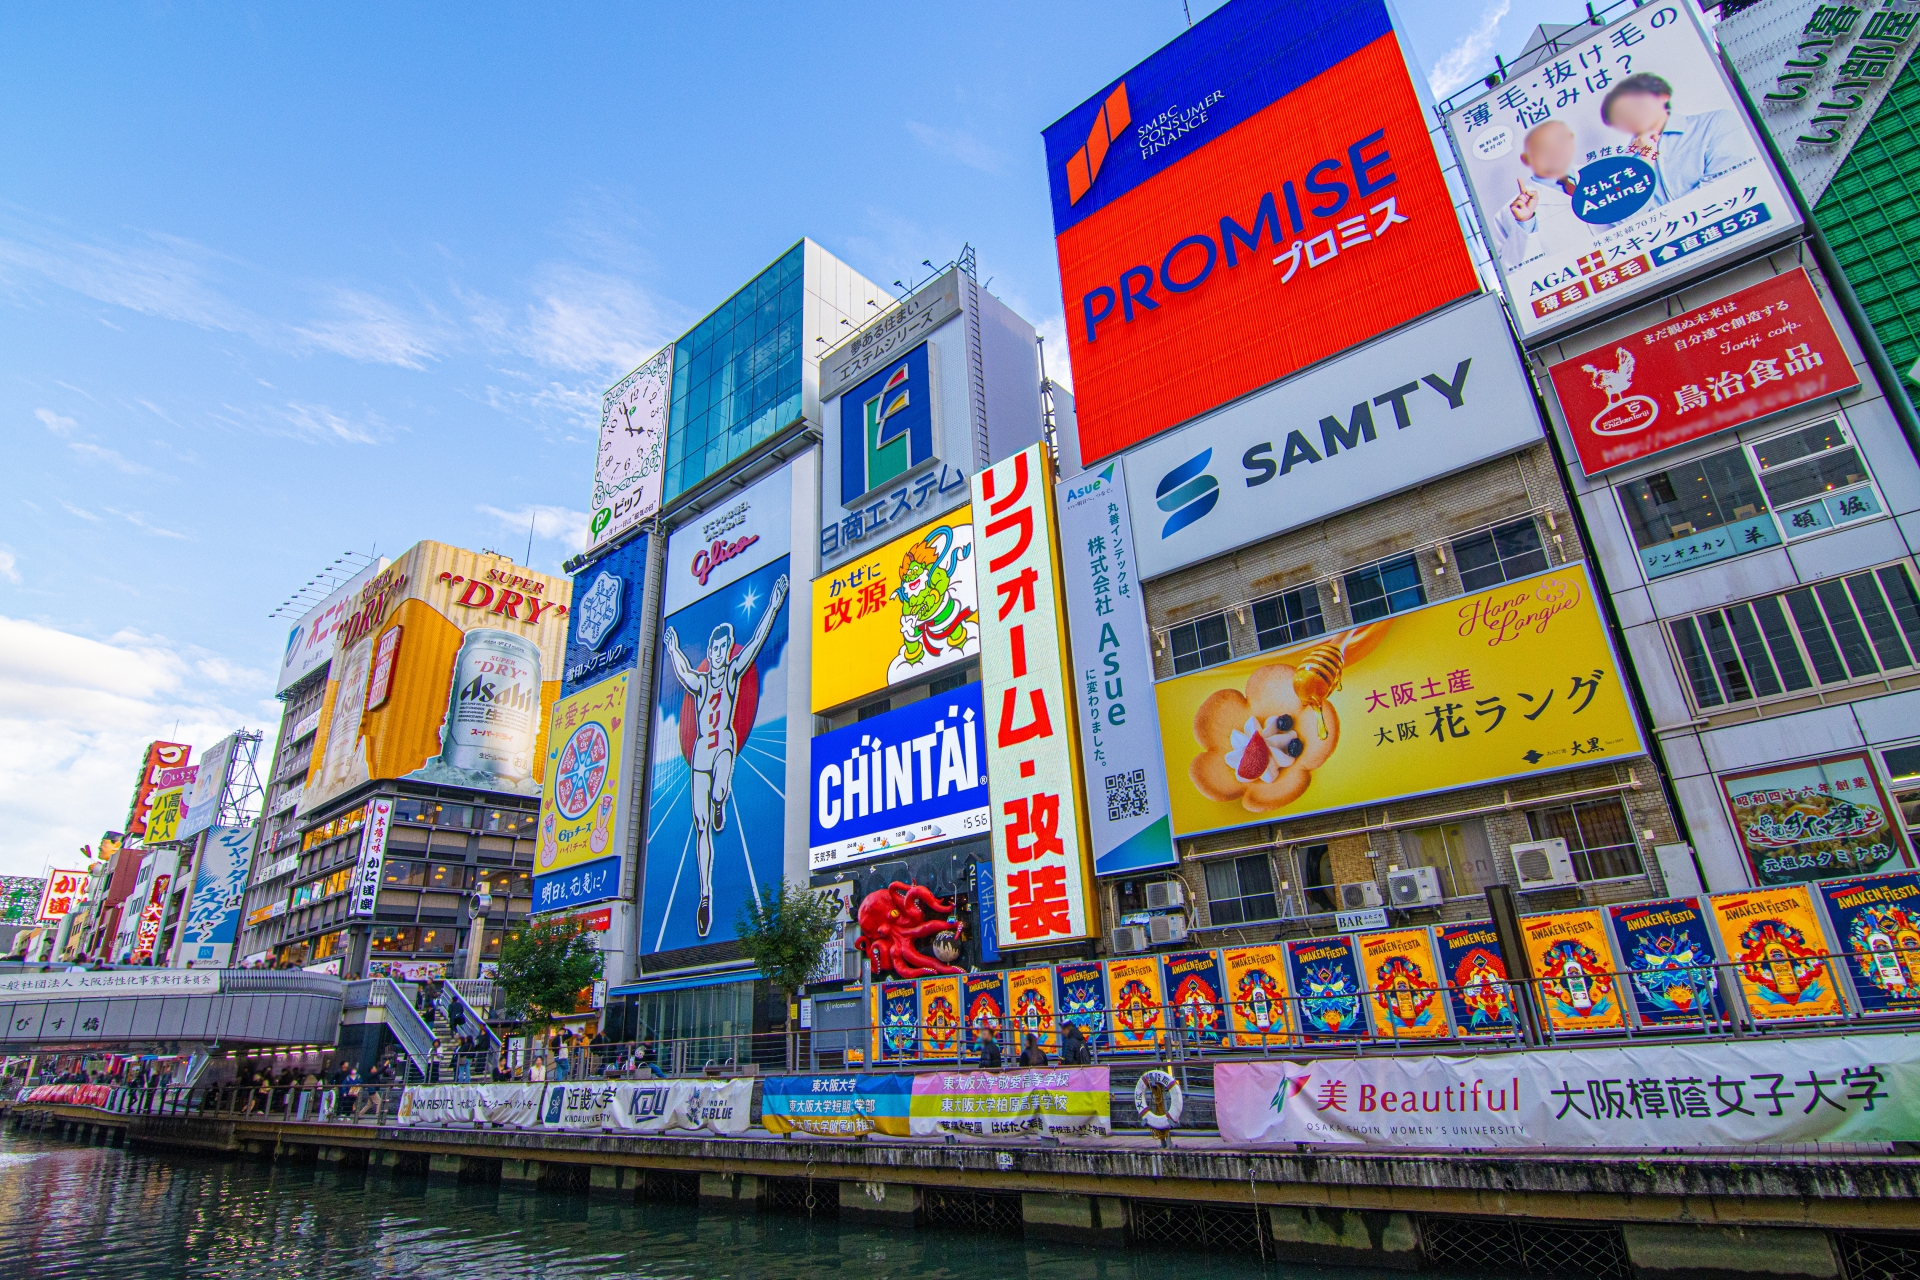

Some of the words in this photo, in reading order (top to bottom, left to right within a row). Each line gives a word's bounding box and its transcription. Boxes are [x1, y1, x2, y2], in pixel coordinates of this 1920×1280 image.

[1462, 6, 1678, 133] 薄毛・抜け毛の
[1137, 104, 1179, 138] SMBC
[1138, 89, 1226, 150] CONSUMER
[1141, 110, 1210, 161] FINANCE
[1585, 143, 1660, 163] 男性も女性も
[1582, 175, 1652, 216] Asking!
[1583, 166, 1636, 197] なんでも
[1083, 127, 1398, 344] PROMISE
[1271, 196, 1411, 285] プロミス
[1529, 266, 1578, 297] AGA
[1608, 186, 1759, 262] スキンクリニック
[1680, 209, 1760, 253] 直進5分
[1539, 285, 1583, 314] 薄毛
[1598, 259, 1642, 288] 発毛
[850, 301, 919, 356] 夢ある住まい
[1674, 300, 1790, 352] 自分達で創造する
[840, 309, 933, 382] エステムシリーズ
[642, 385, 649, 398] 1
[1675, 342, 1825, 416] 鳥治食品
[630, 389, 639, 404] 12
[649, 391, 658, 404] 2
[1242, 357, 1473, 488] SAMTY
[605, 455, 613, 467] 8
[612, 461, 621, 474] 7
[624, 458, 631, 471] 6
[613, 486, 644, 519] ピップ
[1067, 480, 1102, 503] Asue
[820, 464, 965, 557] 日商エステム
[691, 534, 760, 586] Glico
[1648, 538, 1726, 567] ジンギスカン
[487, 567, 545, 595] SUPER
[829, 562, 881, 597] かぜに
[1087, 535, 1114, 617] 株式会社
[824, 577, 887, 633] 改源
[1458, 592, 1531, 637] Hana
[1488, 597, 1577, 647] Langue
[490, 655, 516, 666] SUPER
[566, 643, 623, 682] 雪印メグミルク
[1098, 621, 1126, 726] Asue
[460, 673, 533, 713] Asahi
[981, 451, 1072, 941] リフォーム・改装
[1365, 668, 1475, 713] 大阪土産
[707, 687, 724, 750] グリコ
[1374, 719, 1419, 747] 大阪
[1425, 669, 1605, 743] 花ラング
[470, 728, 514, 742] スーパードライ
[1571, 736, 1605, 756] 大黒
[1735, 776, 1869, 808] 昭和四十六年創業
[371, 816, 386, 853] 本場の味
[360, 857, 380, 911] かに道楽
[1837, 888, 1884, 910] AWAKEN
[1883, 884, 1920, 902] FIESTA
[1337, 915, 1364, 928] BAR
[1627, 912, 1665, 932] AWAKEN
[1665, 909, 1696, 926] FIESTA
[1724, 902, 1767, 921] AWAKEN
[1767, 898, 1800, 915] FIESTA
[133, 901, 163, 960] 大阪王
[1449, 933, 1480, 949] AWAKEN
[1480, 931, 1498, 945] FIES
[1531, 924, 1566, 941] AWAKEN
[1566, 920, 1594, 936] FIESTA
[1299, 948, 1327, 964] AWAKEN
[1326, 946, 1348, 960] FIESTA
[1368, 941, 1398, 957] AWAKEN
[1397, 939, 1421, 953] FIESTA
[78, 975, 212, 987] 大阪活性化事業実行委員会
[831, 1001, 857, 1010] information
[566, 1086, 617, 1110] 近畿大学
[811, 1078, 857, 1092] 東大阪大学
[943, 1072, 1070, 1091] 東大阪大学敬愛高等学校
[1317, 1079, 1348, 1113] 美
[1358, 1077, 1519, 1113] Beautiful
[1550, 1065, 1890, 1121] 大阪樟蔭女子大学
[788, 1099, 876, 1113] 東大阪大学短期学部
[941, 1093, 1068, 1113] 東大阪大学柏原高等学校
[1306, 1122, 1344, 1132] OSAKA
[1346, 1125, 1381, 1135] SHOIN
[1452, 1125, 1526, 1135] UNIVERSITY
